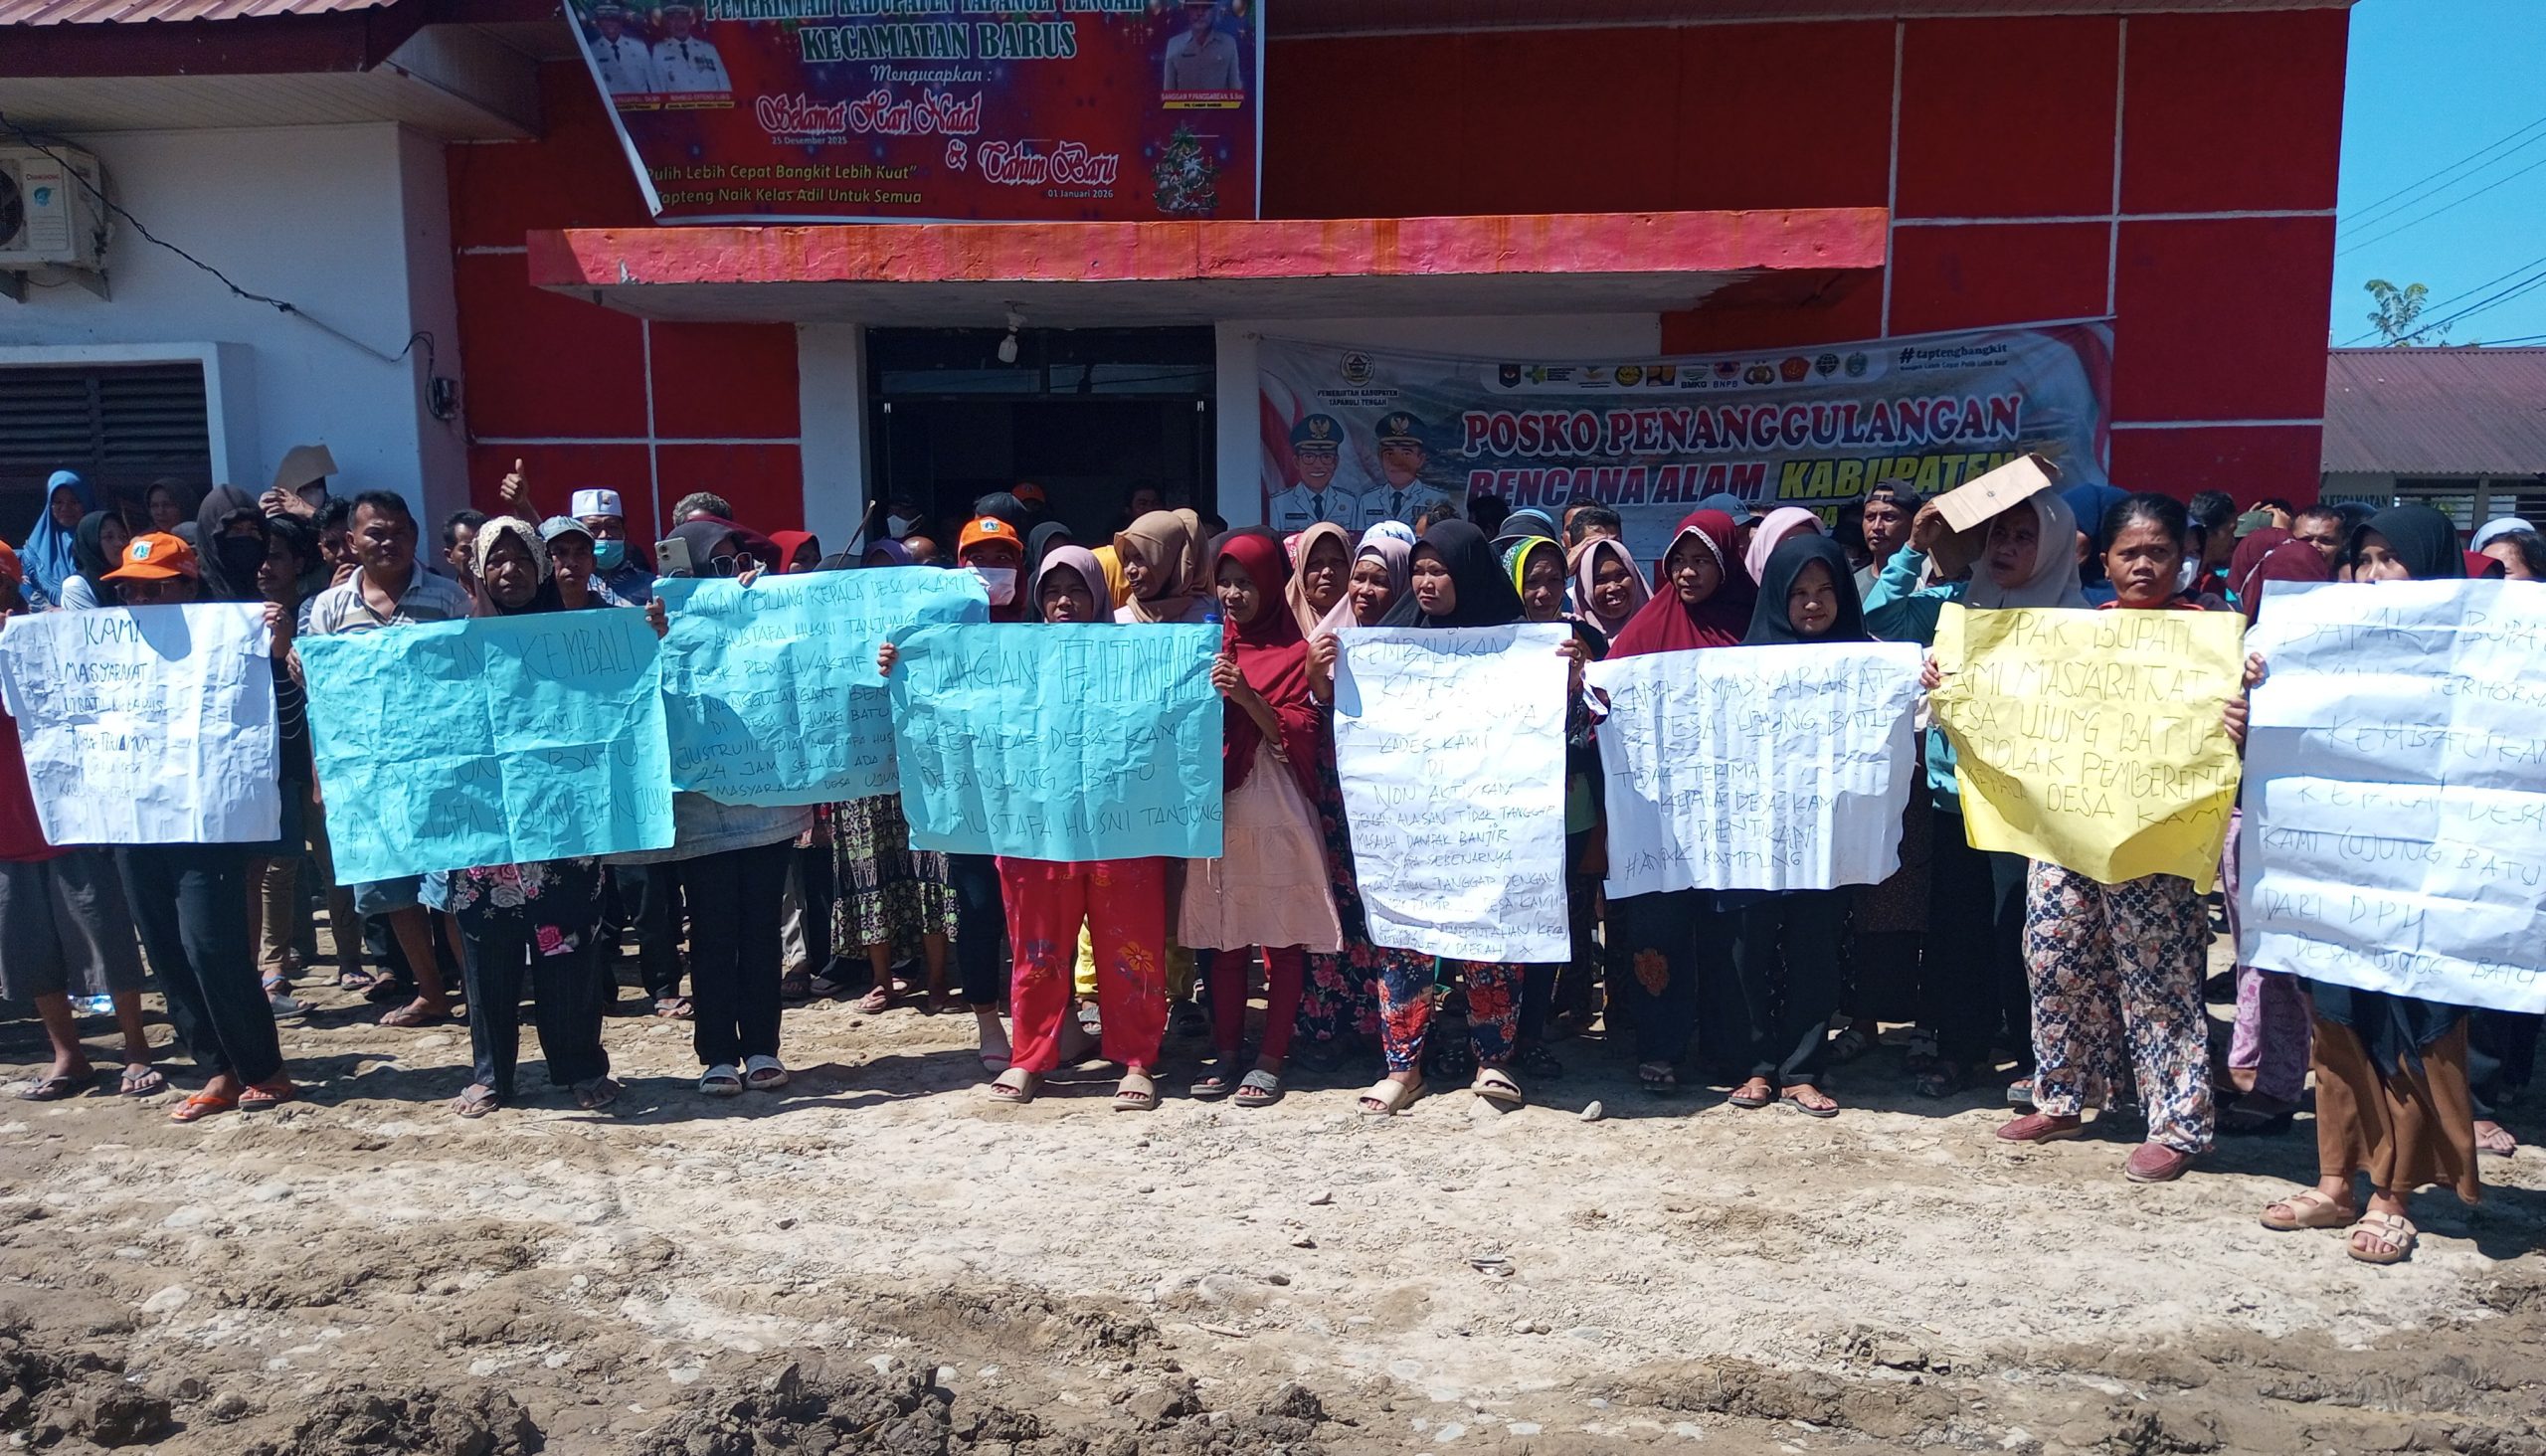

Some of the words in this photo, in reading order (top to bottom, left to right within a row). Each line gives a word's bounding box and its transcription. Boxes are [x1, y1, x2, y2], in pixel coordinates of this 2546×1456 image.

[800, 22, 970, 62] KECAMATAN
[977, 21, 1077, 60] BARUS
[870, 64, 983, 86] Mengucapkan
[756, 91, 848, 134] Selamat
[848, 90, 914, 134] Hari
[914, 88, 983, 135] Natal
[772, 135, 784, 145] 25
[686, 164, 725, 179] Lebih
[730, 165, 772, 181] Cepat
[776, 165, 831, 181] Bangkit
[837, 165, 874, 179] Lebih
[946, 138, 969, 172] &
[977, 138, 1047, 186] Tahun
[1049, 139, 1121, 185] Baru
[719, 188, 753, 203] Naik
[757, 188, 795, 203] Kelas
[798, 188, 824, 202] Adil
[829, 188, 871, 203] Untuk
[875, 190, 922, 204] Semua
[1048, 190, 1058, 199] 01
[1061, 189, 1090, 199] Januari
[1094, 189, 1114, 199] 2026
[1463, 411, 1599, 456] POSKO
[1606, 393, 2023, 455] PENANGGULANGAN
[1466, 466, 1647, 507] BENCANA
[1650, 462, 1768, 504] ALAM
[681, 591, 743, 619] JANGAN
[749, 585, 803, 612] BILANG
[807, 583, 864, 606] KEPALA
[917, 574, 966, 596] KAMI
[84, 616, 140, 645] KAMI
[715, 625, 787, 650] MUSTAFA
[795, 622, 835, 637] HUSNI
[844, 611, 916, 636] TANJUNG
[2015, 612, 2069, 646] PAK
[2092, 617, 2193, 655] BUPATI
[516, 621, 637, 684] KEMBALI
[65, 662, 148, 683] MASYARAKAT
[910, 648, 1039, 697] JANGAN
[1057, 635, 1201, 705] FITNAH
[1699, 665, 1896, 705] MASYARAKAT
[2014, 659, 2209, 706] MASYARAKAT
[685, 687, 839, 718] PENANGGULANGAN
[515, 710, 584, 734] KAMI
[713, 723, 728, 736] DI
[745, 714, 777, 731] DESA
[791, 708, 844, 729] UJUNG
[852, 707, 891, 723] BATU
[1655, 713, 1718, 739] DESA
[1828, 709, 1888, 736] BATU
[2020, 702, 2100, 747] UJUNG
[2119, 712, 2206, 756] BATU
[778, 738, 800, 754] DIA
[922, 720, 1026, 756] KEPALA
[1050, 725, 1107, 754] DESA
[1125, 722, 1184, 751] KAMI
[1378, 736, 1433, 754] KADES
[1441, 727, 1489, 752] KAMI
[547, 742, 638, 775] BATU
[696, 767, 727, 783] 24
[740, 762, 780, 776] JAM
[792, 758, 842, 774] SELALU
[855, 755, 878, 767] ADA
[1427, 758, 1445, 777] DI
[1685, 762, 1759, 782] TERIMA
[716, 781, 813, 797] MASYARAKAT
[824, 779, 850, 790] DESA
[921, 767, 973, 796] DESA
[978, 766, 1056, 791] UJUNG
[1084, 763, 1156, 788] BATU
[1373, 785, 1416, 808] NON
[1660, 790, 1728, 813] KEPALA
[1735, 793, 1778, 815] DESA
[1793, 794, 1839, 815] KAMI
[2048, 783, 2115, 819] DESA
[949, 807, 1052, 839] MUSTAFA
[1062, 810, 1131, 837] HUSNI
[1139, 804, 1222, 827] TANJUNG
[1396, 812, 1447, 826] ALASAN
[1698, 819, 1815, 849] DIHENTIKAN
[1459, 826, 1511, 847] BANJIR
[2264, 827, 2318, 852] KAMI
[2456, 848, 2541, 886] BATU
[1431, 876, 1497, 892] TANGGAP
[1503, 869, 1558, 889] DENGAN
[2264, 889, 2322, 921] DARI
[2296, 931, 2351, 963] DESA
